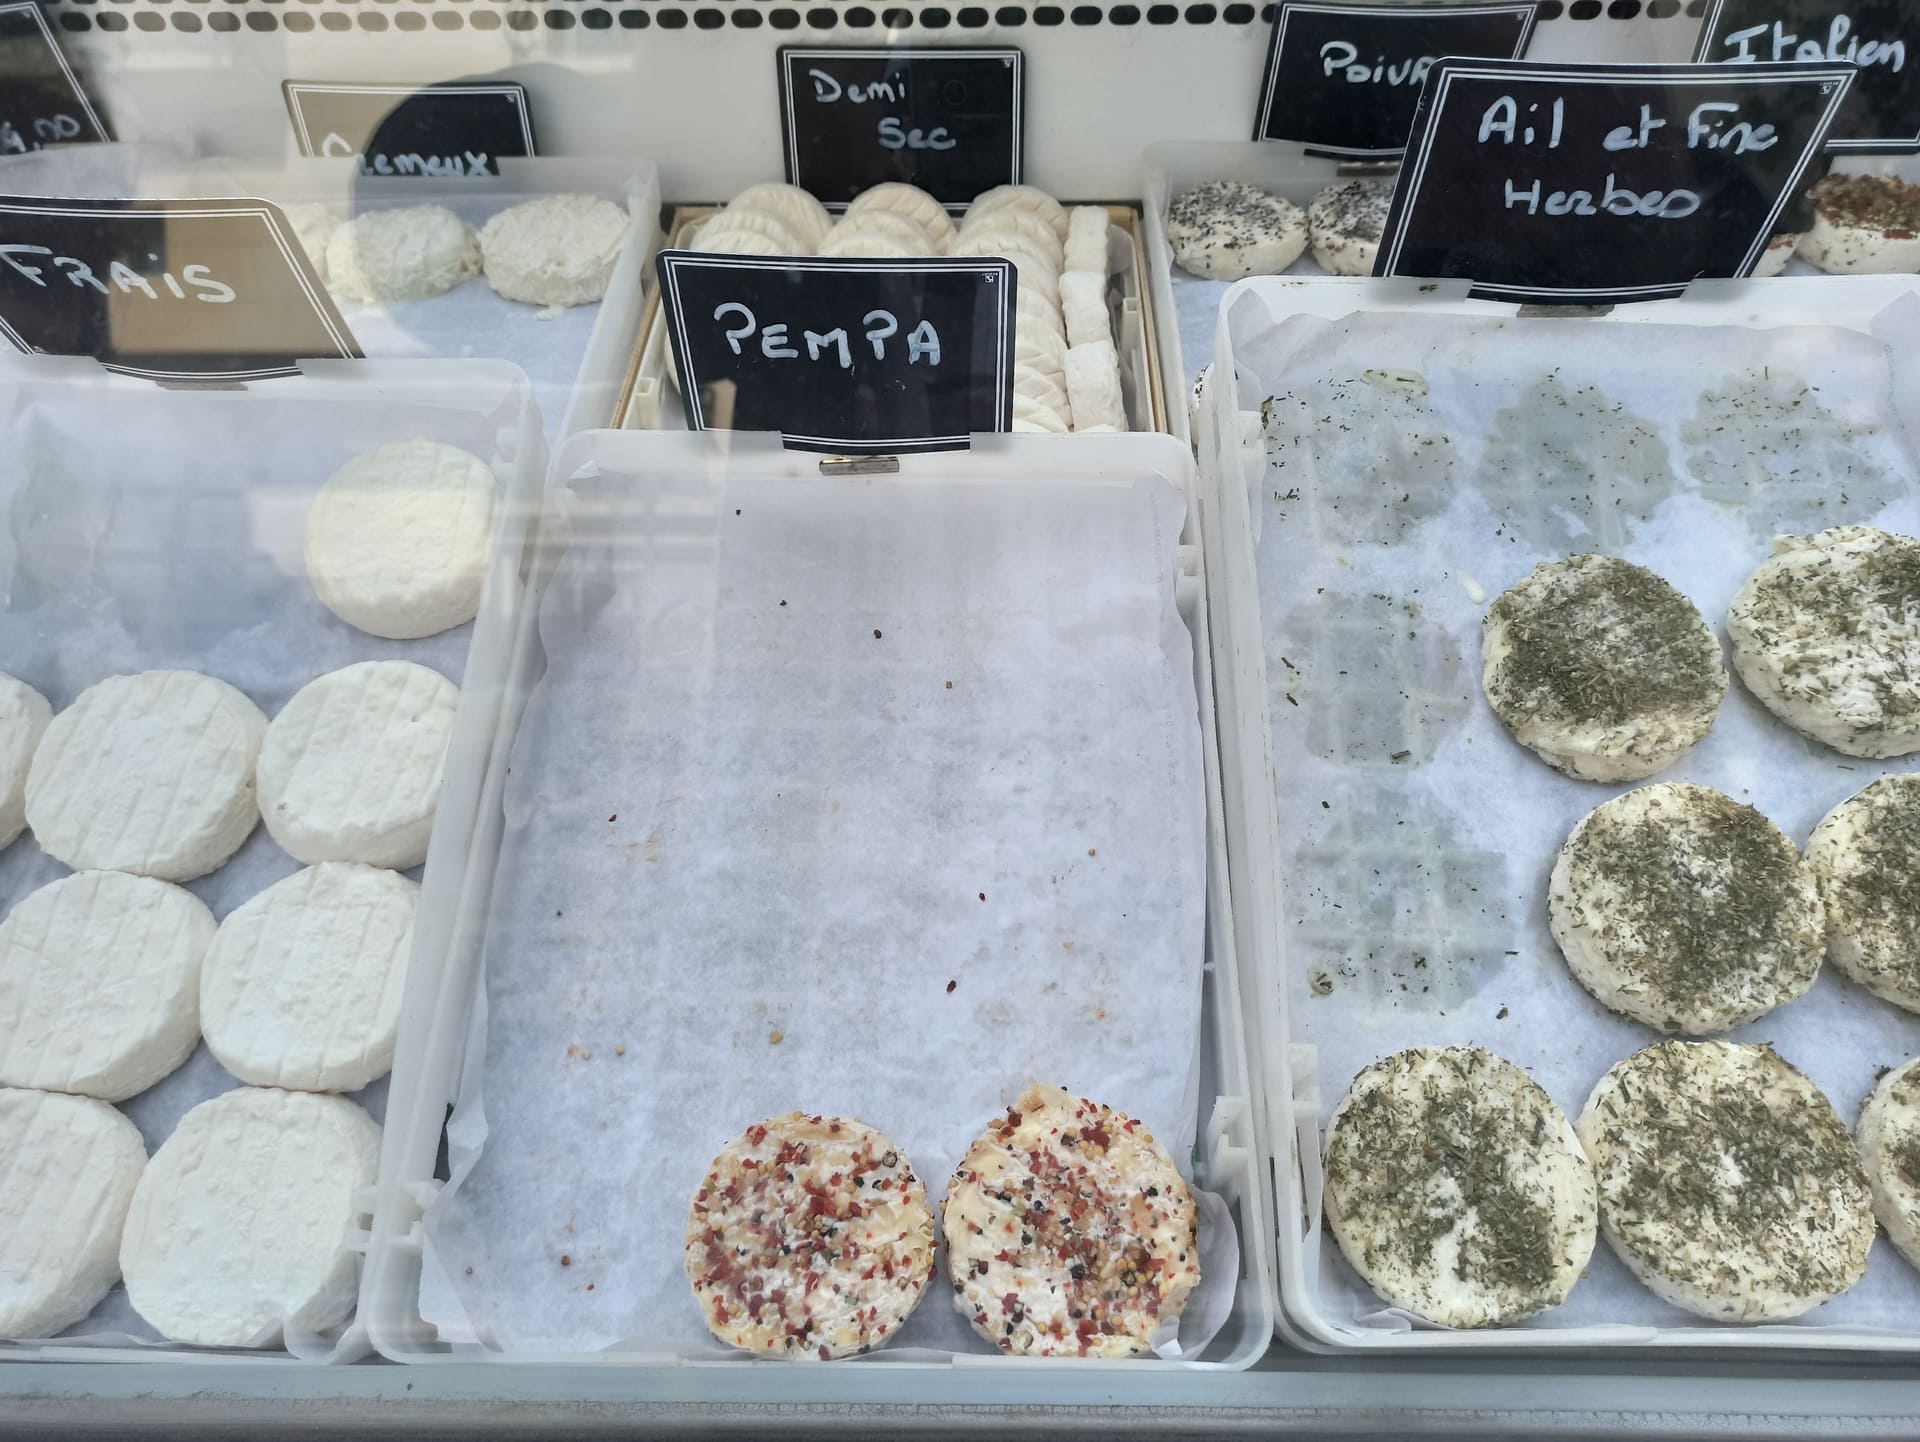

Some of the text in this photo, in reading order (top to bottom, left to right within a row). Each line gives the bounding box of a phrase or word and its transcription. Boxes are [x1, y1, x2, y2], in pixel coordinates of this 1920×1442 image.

[1722, 14, 1905, 72] Italien
[808, 68, 906, 103] Demi
[877, 117, 957, 150] Sec
[1478, 95, 1779, 155] Ail et Fine
[713, 302, 942, 368] PEMPA
